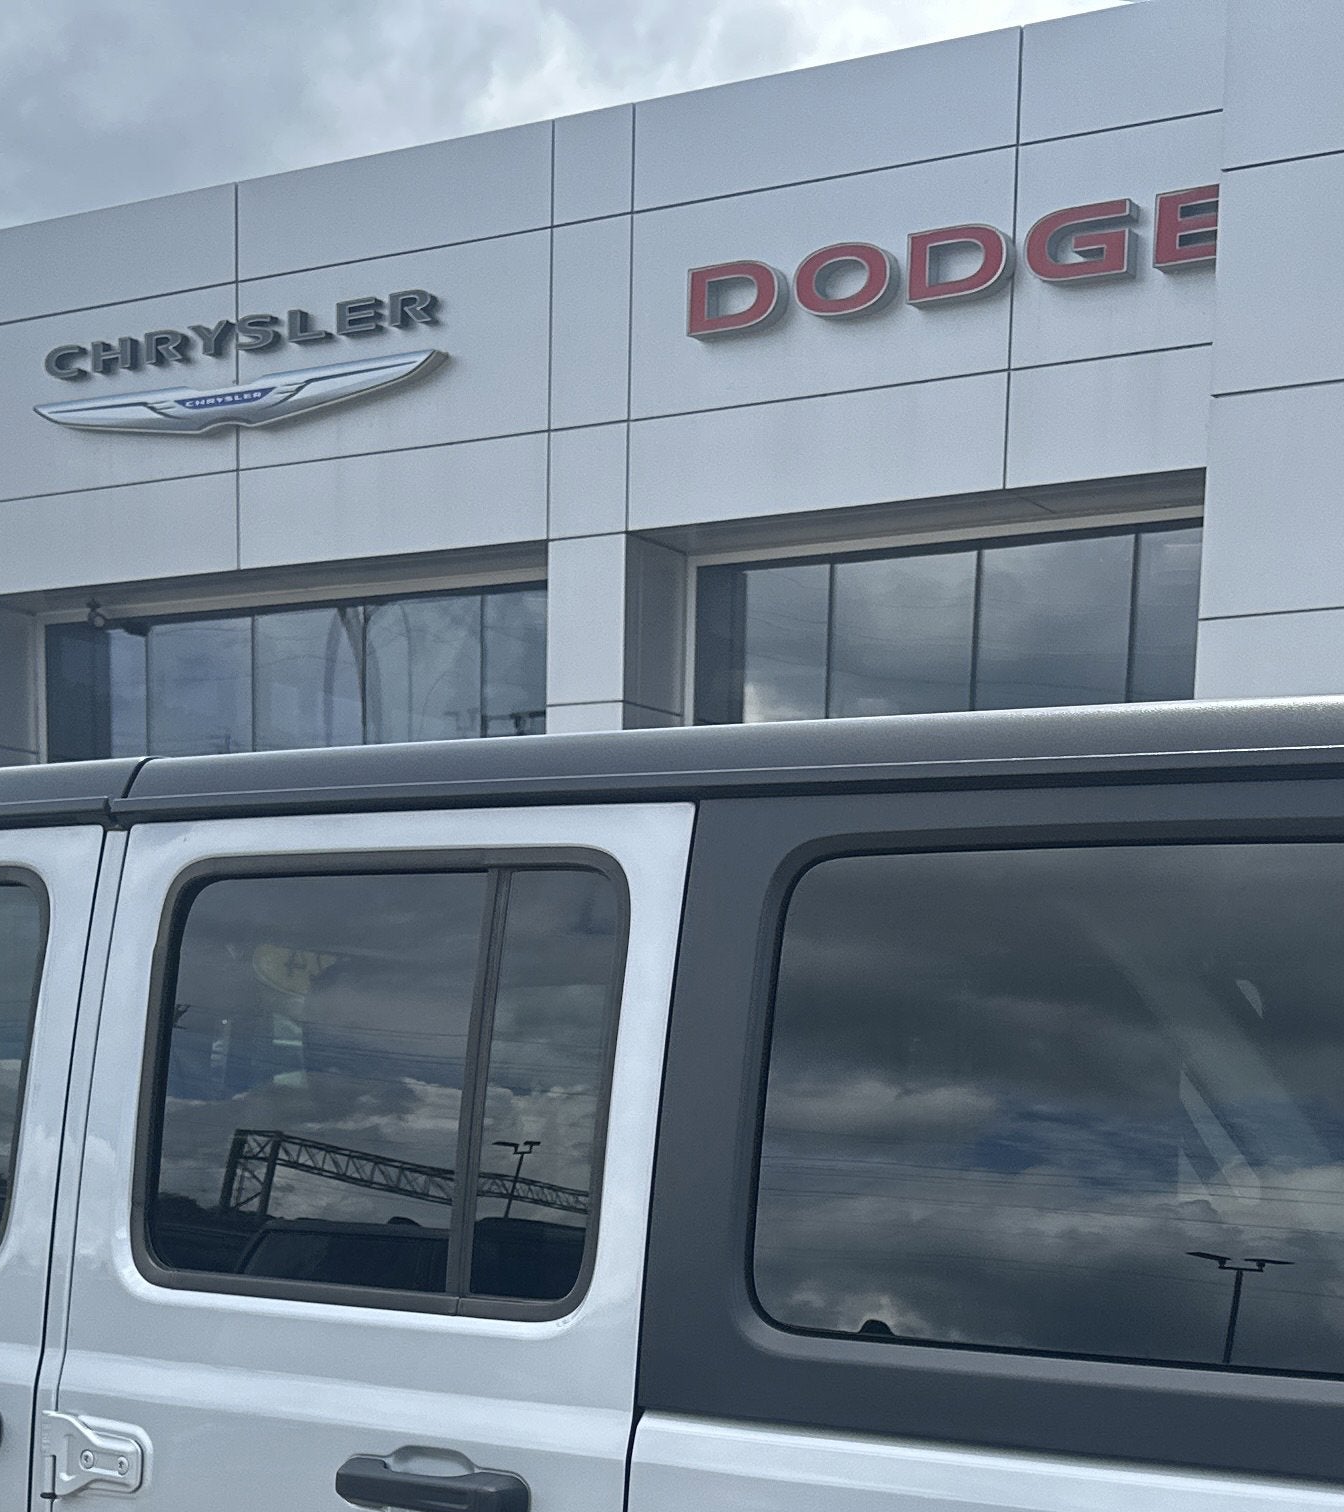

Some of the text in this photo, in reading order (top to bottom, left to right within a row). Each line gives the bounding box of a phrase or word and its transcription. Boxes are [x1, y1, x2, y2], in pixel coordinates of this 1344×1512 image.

[686, 183, 1220, 340] DODGE
[44, 288, 440, 382] CHRYSLER
[184, 391, 262, 407] CHRYSLER
